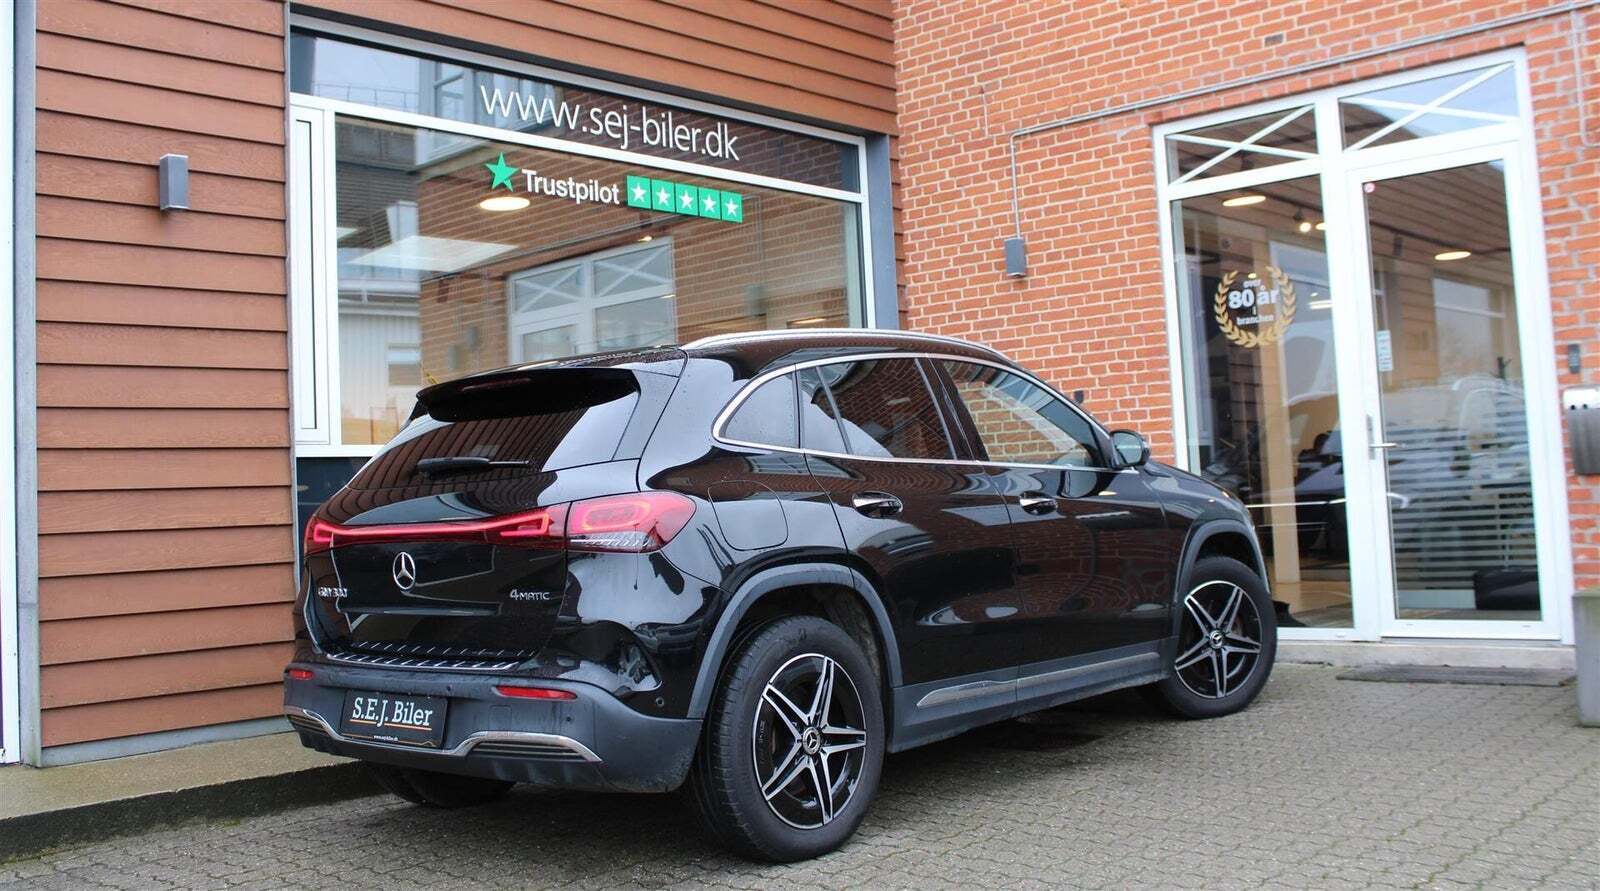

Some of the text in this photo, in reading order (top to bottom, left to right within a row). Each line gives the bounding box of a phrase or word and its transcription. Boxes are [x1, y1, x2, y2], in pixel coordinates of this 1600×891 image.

[480, 85, 740, 161] www.sej-biler.dk
[521, 168, 620, 205] Trustpilot
[1228, 285, 1279, 309] 80 år
[1236, 314, 1274, 326] branchen
[510, 589, 550, 600] 4MATIC
[352, 697, 433, 728] S.E.J. Biler
